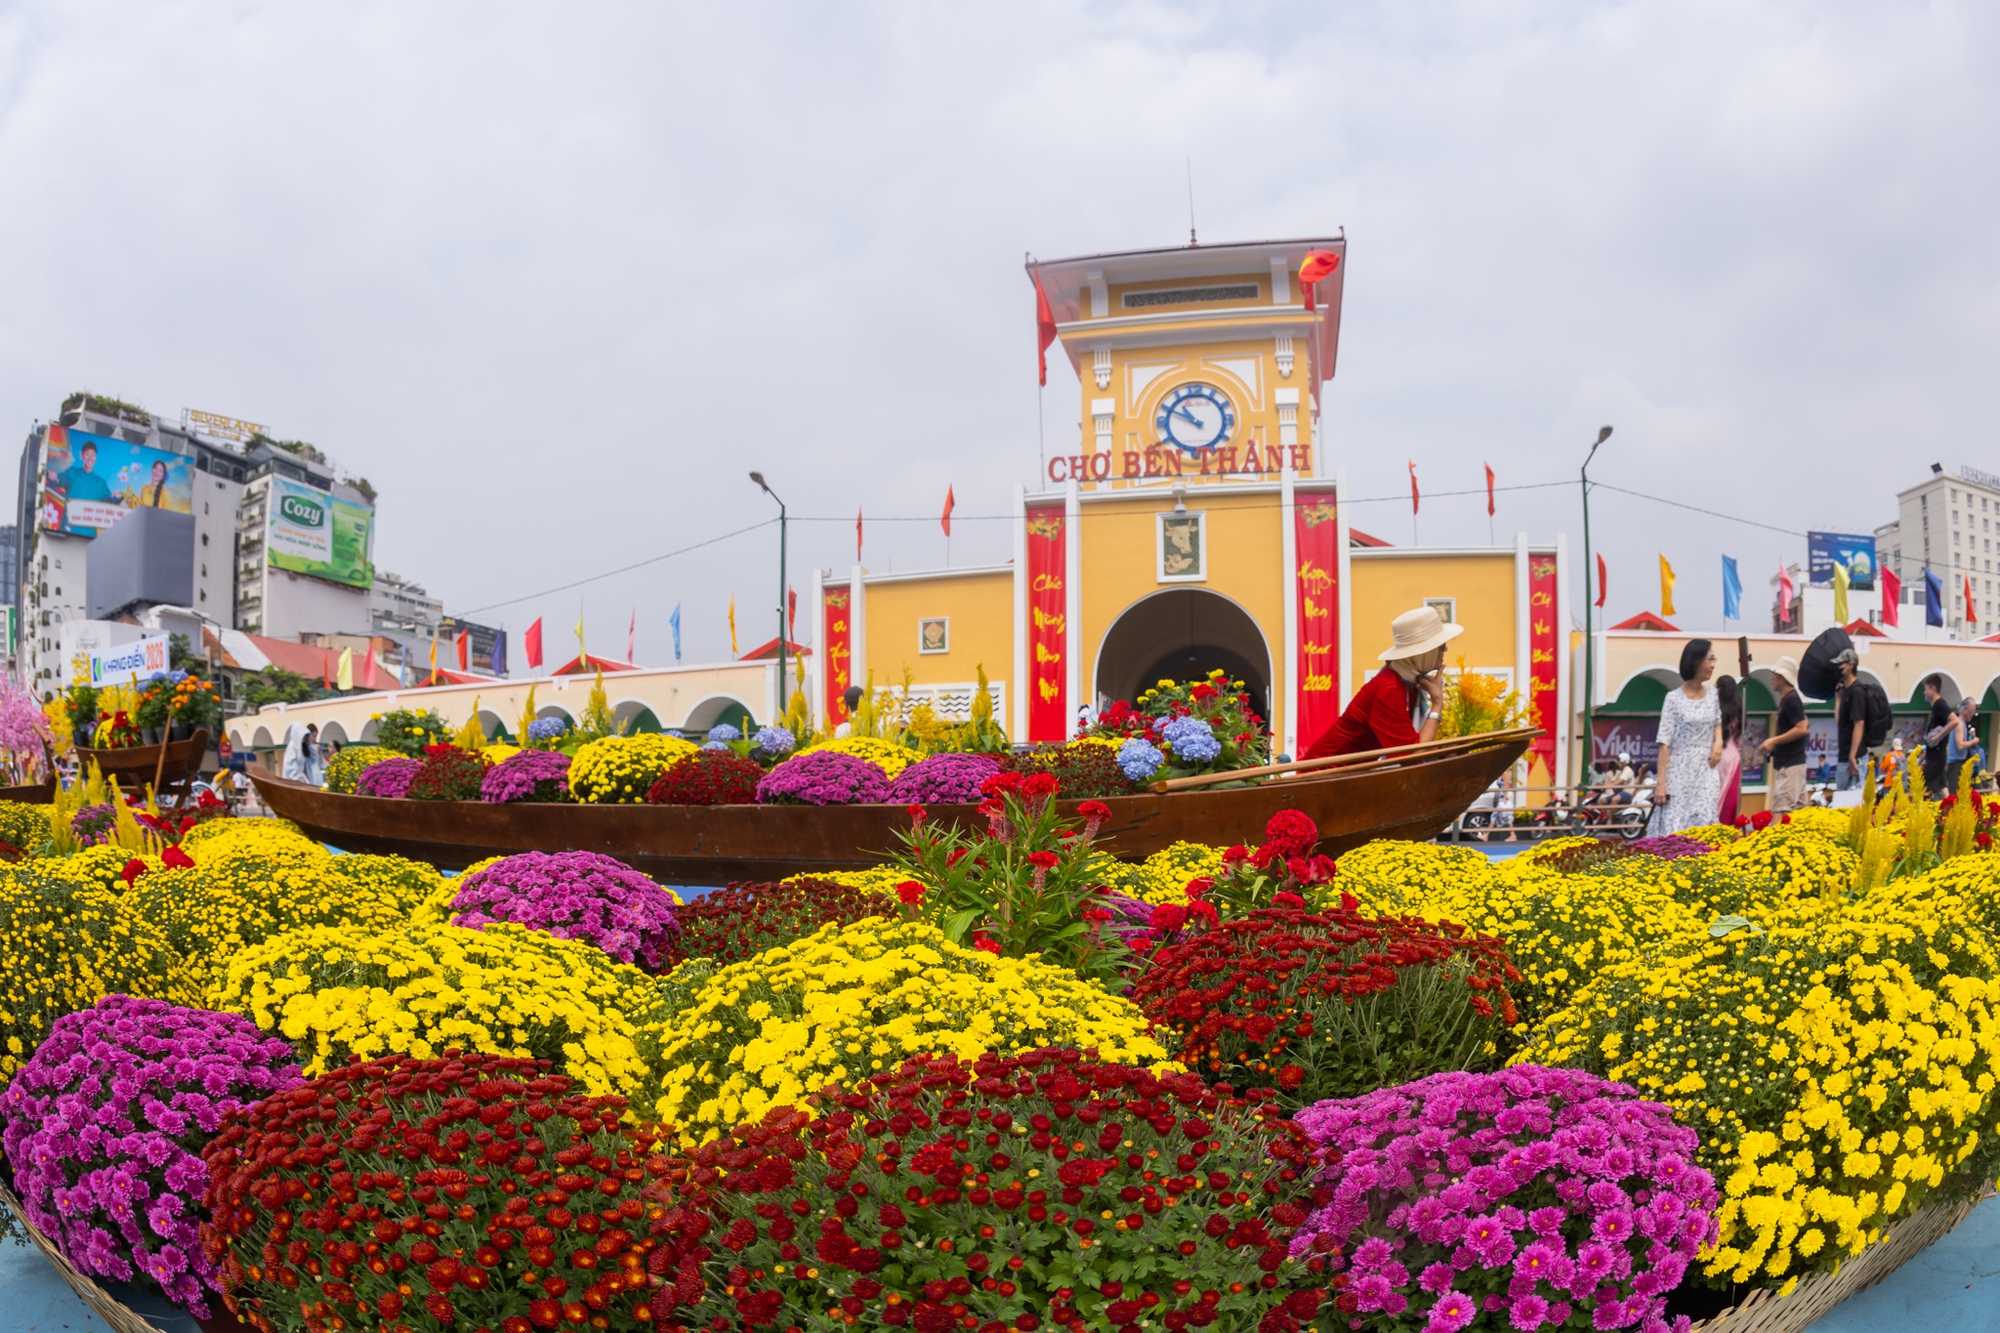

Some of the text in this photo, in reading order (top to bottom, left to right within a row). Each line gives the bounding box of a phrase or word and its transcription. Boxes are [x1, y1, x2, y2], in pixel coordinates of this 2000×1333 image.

[190, 409, 262, 435] SILVERLAND
[1048, 439, 1311, 482] CHỢ BẾN THÀNH
[283, 498, 321, 525] Cozy
[145, 641, 164, 671] 2026
[1303, 674, 1332, 691] 2026
[1594, 725, 1641, 756] Vikki
